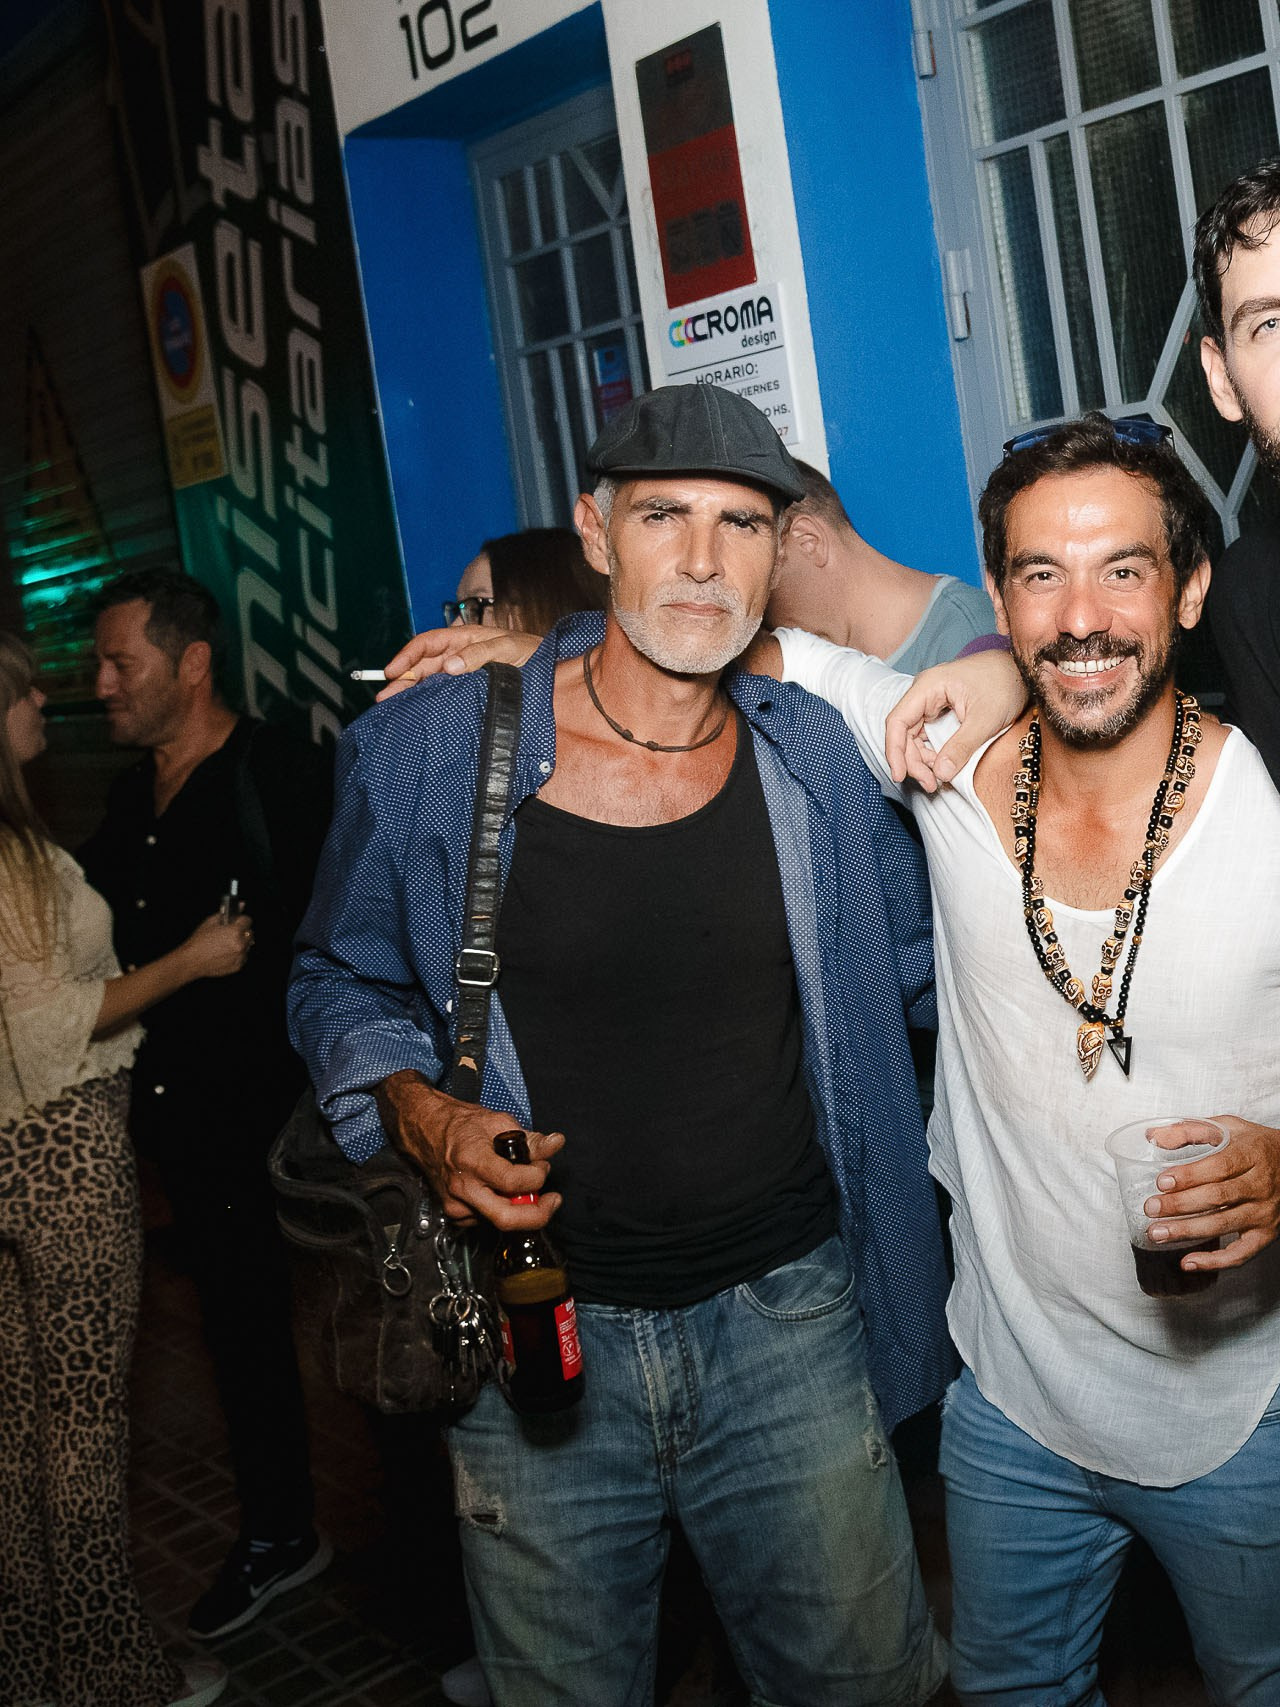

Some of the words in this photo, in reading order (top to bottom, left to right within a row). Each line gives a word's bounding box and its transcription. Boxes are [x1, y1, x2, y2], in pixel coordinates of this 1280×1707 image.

[399, 0, 498, 80] 102
[740, 330, 777, 348] design
[198, 0, 290, 721] miseta
[695, 362, 759, 386] HORARIO:
[736, 380, 780, 398] VIERNES
